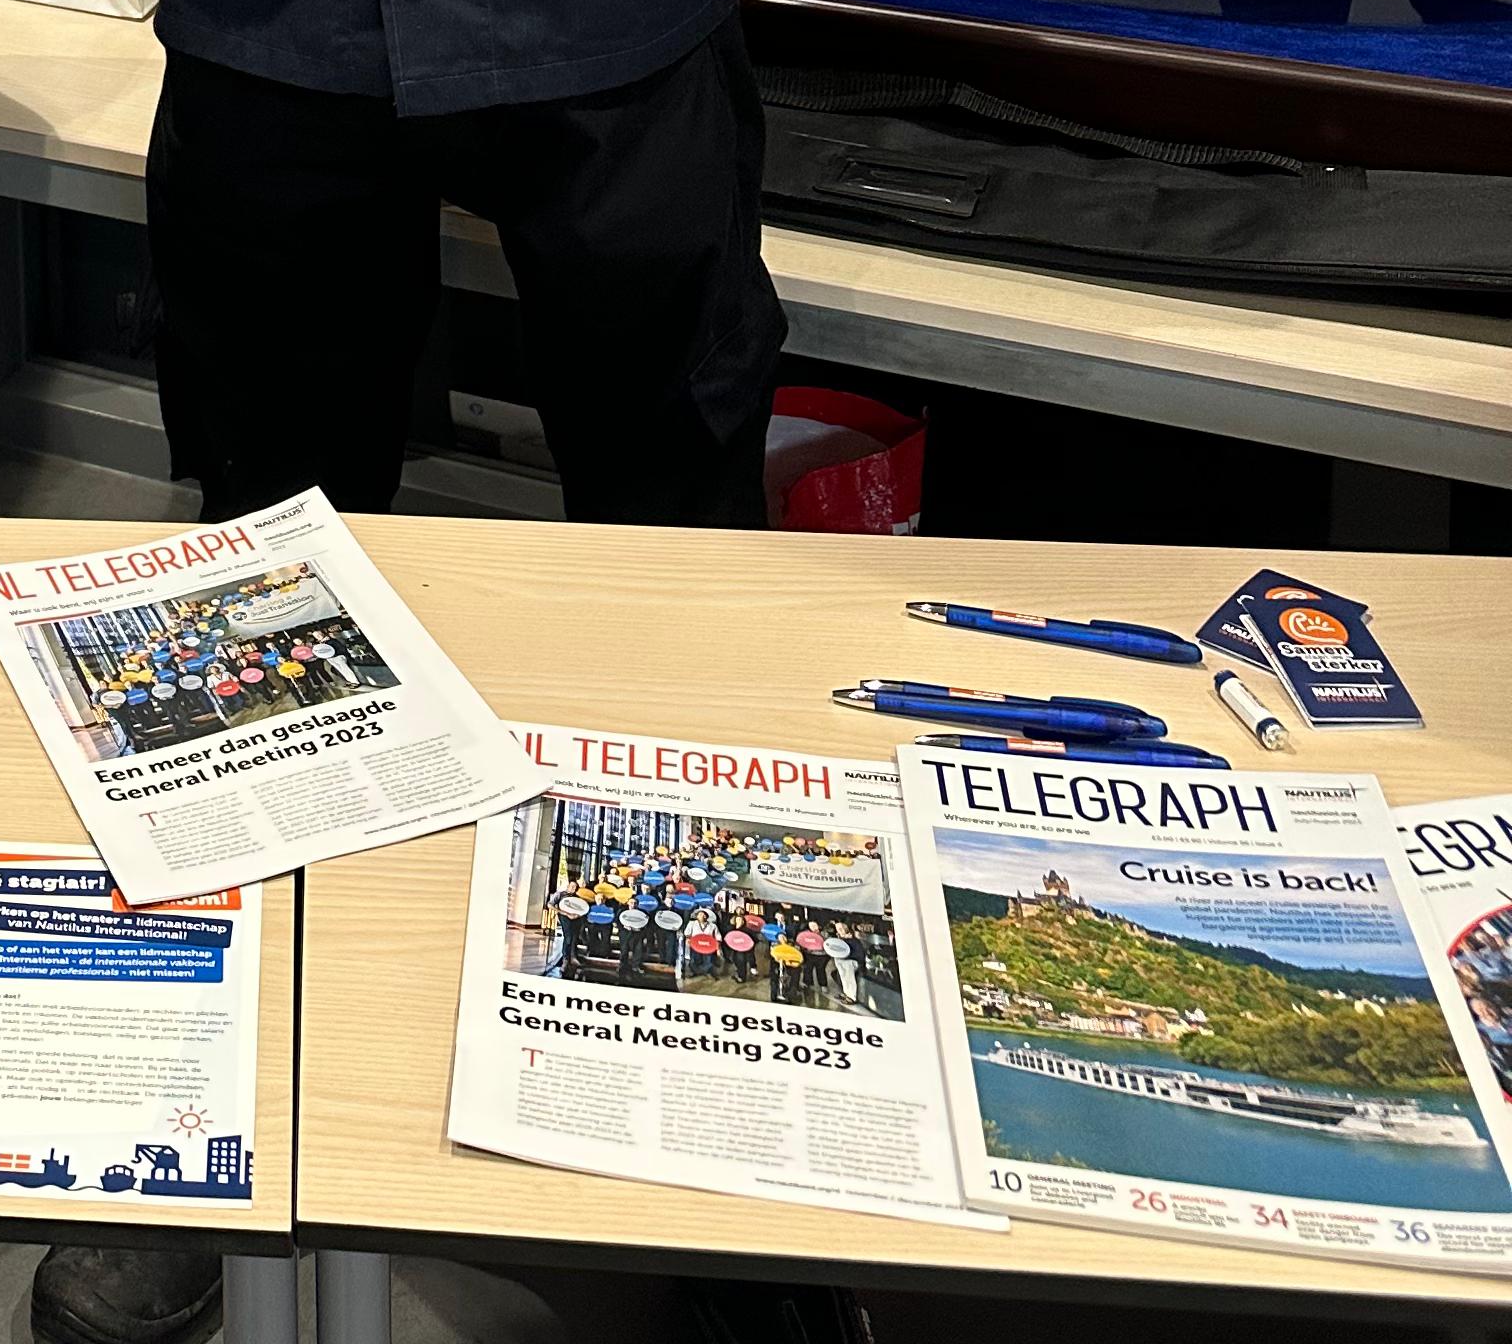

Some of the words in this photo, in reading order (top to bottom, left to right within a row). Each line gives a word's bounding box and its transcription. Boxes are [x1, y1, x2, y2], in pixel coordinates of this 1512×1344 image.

[35, 526, 256, 596] TELEGRAPH
[1280, 644, 1350, 656] Samen
[1312, 660, 1380, 671] sterker
[94, 766, 145, 786] Een
[149, 745, 215, 780] meer
[219, 730, 267, 759] dan
[273, 696, 398, 745] geslaagde
[104, 770, 210, 804] General
[213, 738, 319, 781] Meeting
[321, 721, 385, 753] 2023
[572, 737, 832, 800] TELEGRAPH
[922, 760, 1279, 833] TELEGRAPH
[8, 873, 106, 891] stagiair!
[1119, 860, 1233, 889] Cruise
[1240, 867, 1272, 890] is
[1280, 869, 1378, 894] back!
[30, 910, 49, 922] op
[52, 910, 76, 922] het
[79, 914, 120, 926] water
[136, 917, 227, 935] lidmaatschap
[498, 1005, 623, 1044] General
[633, 1025, 763, 1062] Meeting
[772, 1042, 853, 1072] 2023
[501, 980, 556, 1008] Een
[565, 995, 646, 1021] meer
[653, 1003, 714, 1027] dan
[721, 1013, 885, 1049] geslaagde
[988, 1169, 1023, 1194] 10
[1130, 1188, 1168, 1214] 26
[1251, 1204, 1289, 1230] 34
[1393, 1220, 1431, 1246] 36
